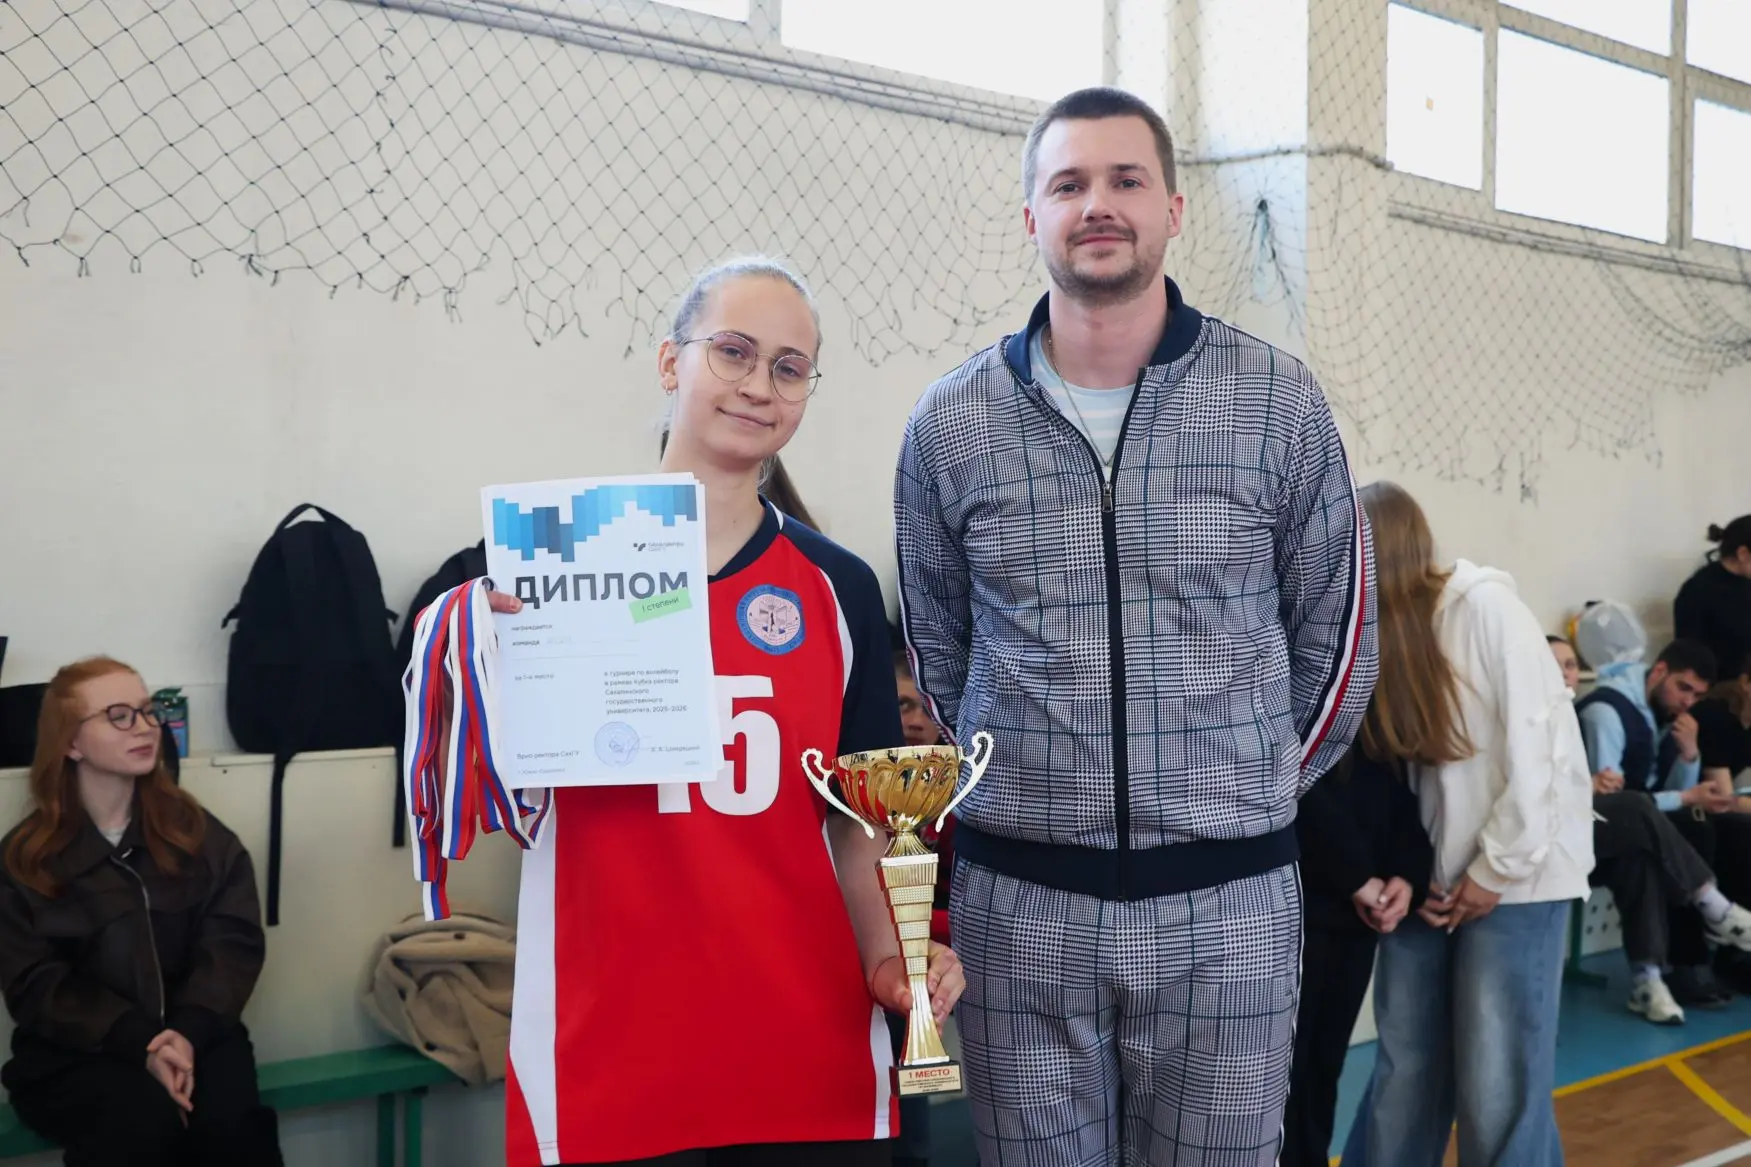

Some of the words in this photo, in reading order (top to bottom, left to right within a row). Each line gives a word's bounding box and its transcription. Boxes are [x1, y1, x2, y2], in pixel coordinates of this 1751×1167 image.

[515, 572, 688, 609] ДИПЛОМ
[648, 597, 680, 611] степени
[606, 698, 663, 706] государственного
[915, 1069, 951, 1078] МЕСТО
